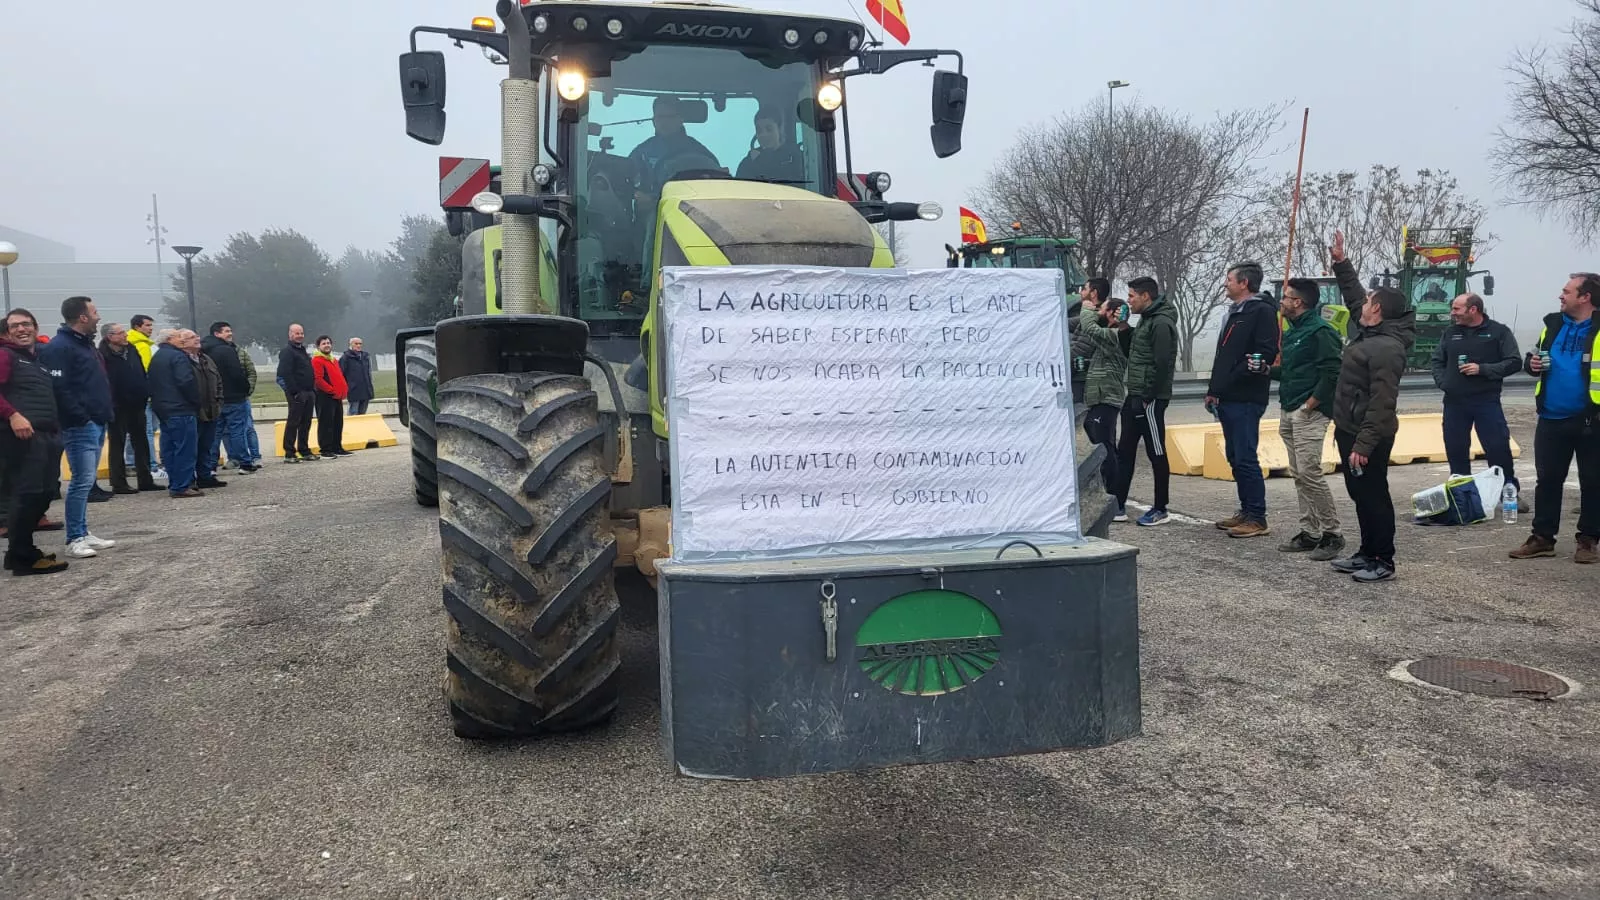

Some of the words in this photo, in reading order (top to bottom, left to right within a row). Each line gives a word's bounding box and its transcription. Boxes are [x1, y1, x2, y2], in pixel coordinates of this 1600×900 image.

[655, 23, 752, 39] AXION
[698, 288, 735, 312] LA
[750, 291, 889, 312] AGRICULTURA
[909, 294, 932, 312] ES
[949, 295, 969, 314] EL
[987, 295, 1027, 312] ARTE
[701, 326, 728, 344] DE
[751, 327, 816, 344] SABER
[942, 326, 992, 343] PERO
[706, 364, 732, 384] SE
[752, 364, 792, 381] NOS
[814, 362, 881, 381] ACABA
[902, 360, 926, 379] LA
[715, 456, 737, 475] LA
[750, 453, 858, 473] AUTENTICA
[873, 448, 1027, 470] CONTAMINACIÓN
[741, 493, 781, 511] ESTA
[801, 492, 824, 508] EN
[842, 492, 862, 508] EL
[893, 489, 990, 506] GOBIERNO
